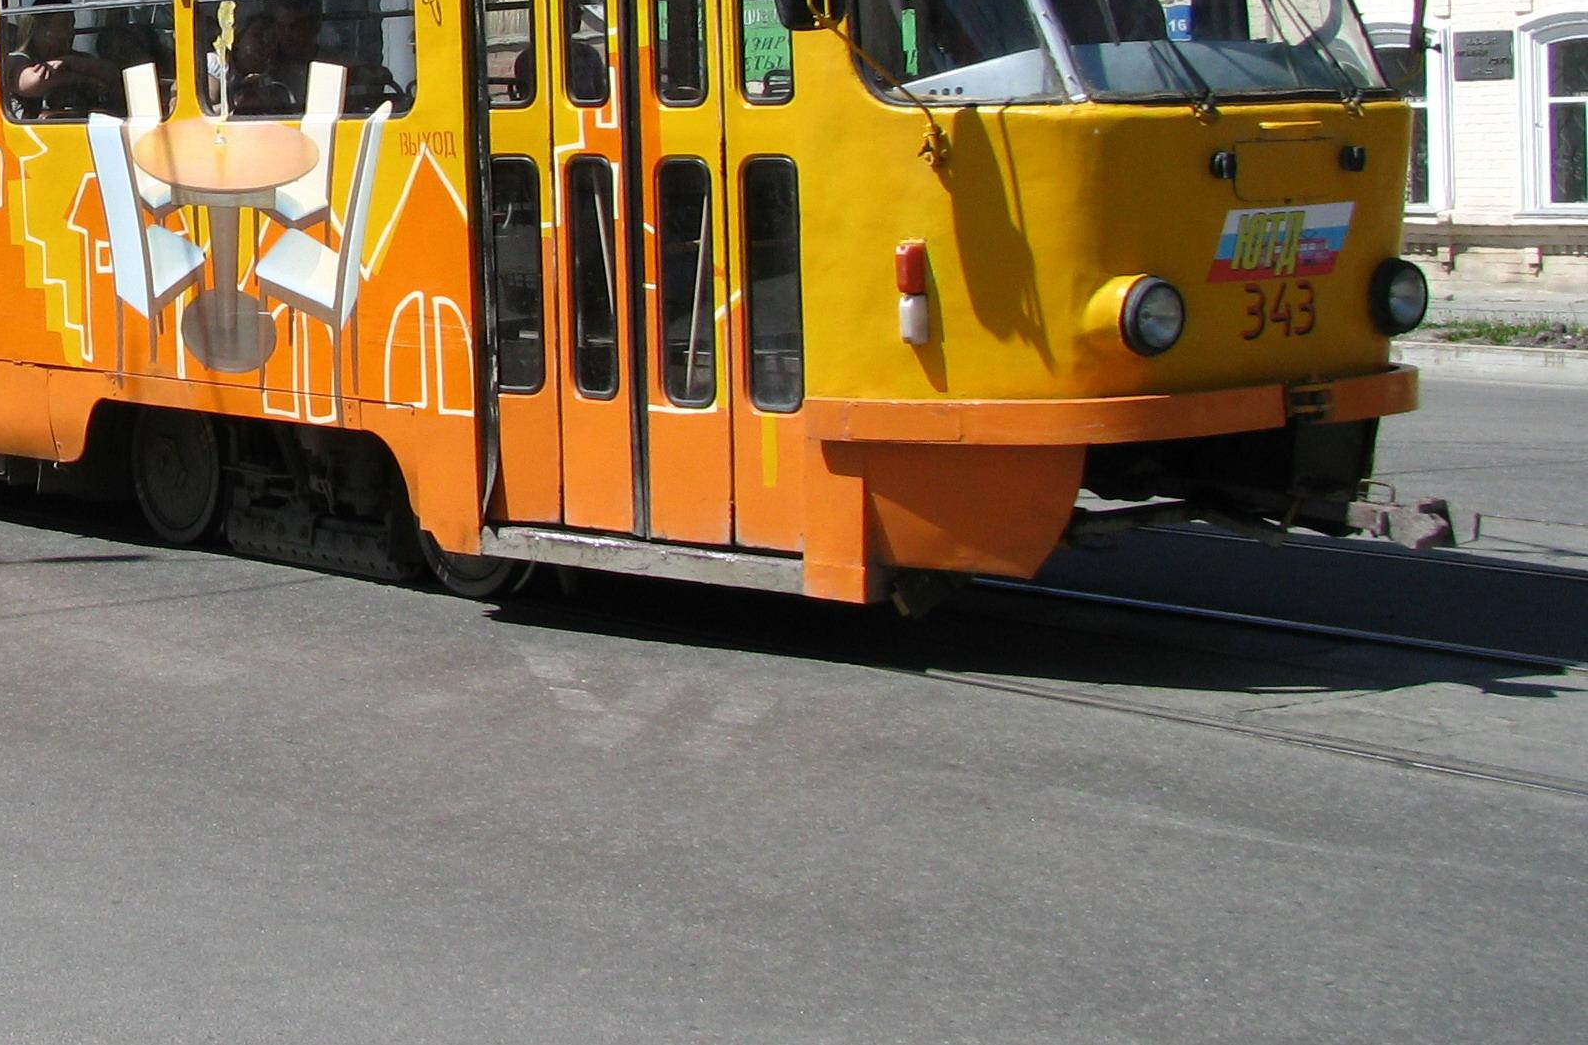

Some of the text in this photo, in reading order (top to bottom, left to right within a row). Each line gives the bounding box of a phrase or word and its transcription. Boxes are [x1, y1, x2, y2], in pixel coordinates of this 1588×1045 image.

[399, 131, 456, 159] ВЫХОД
[1230, 210, 1306, 276] ЮТД
[1241, 279, 1316, 340] 343
